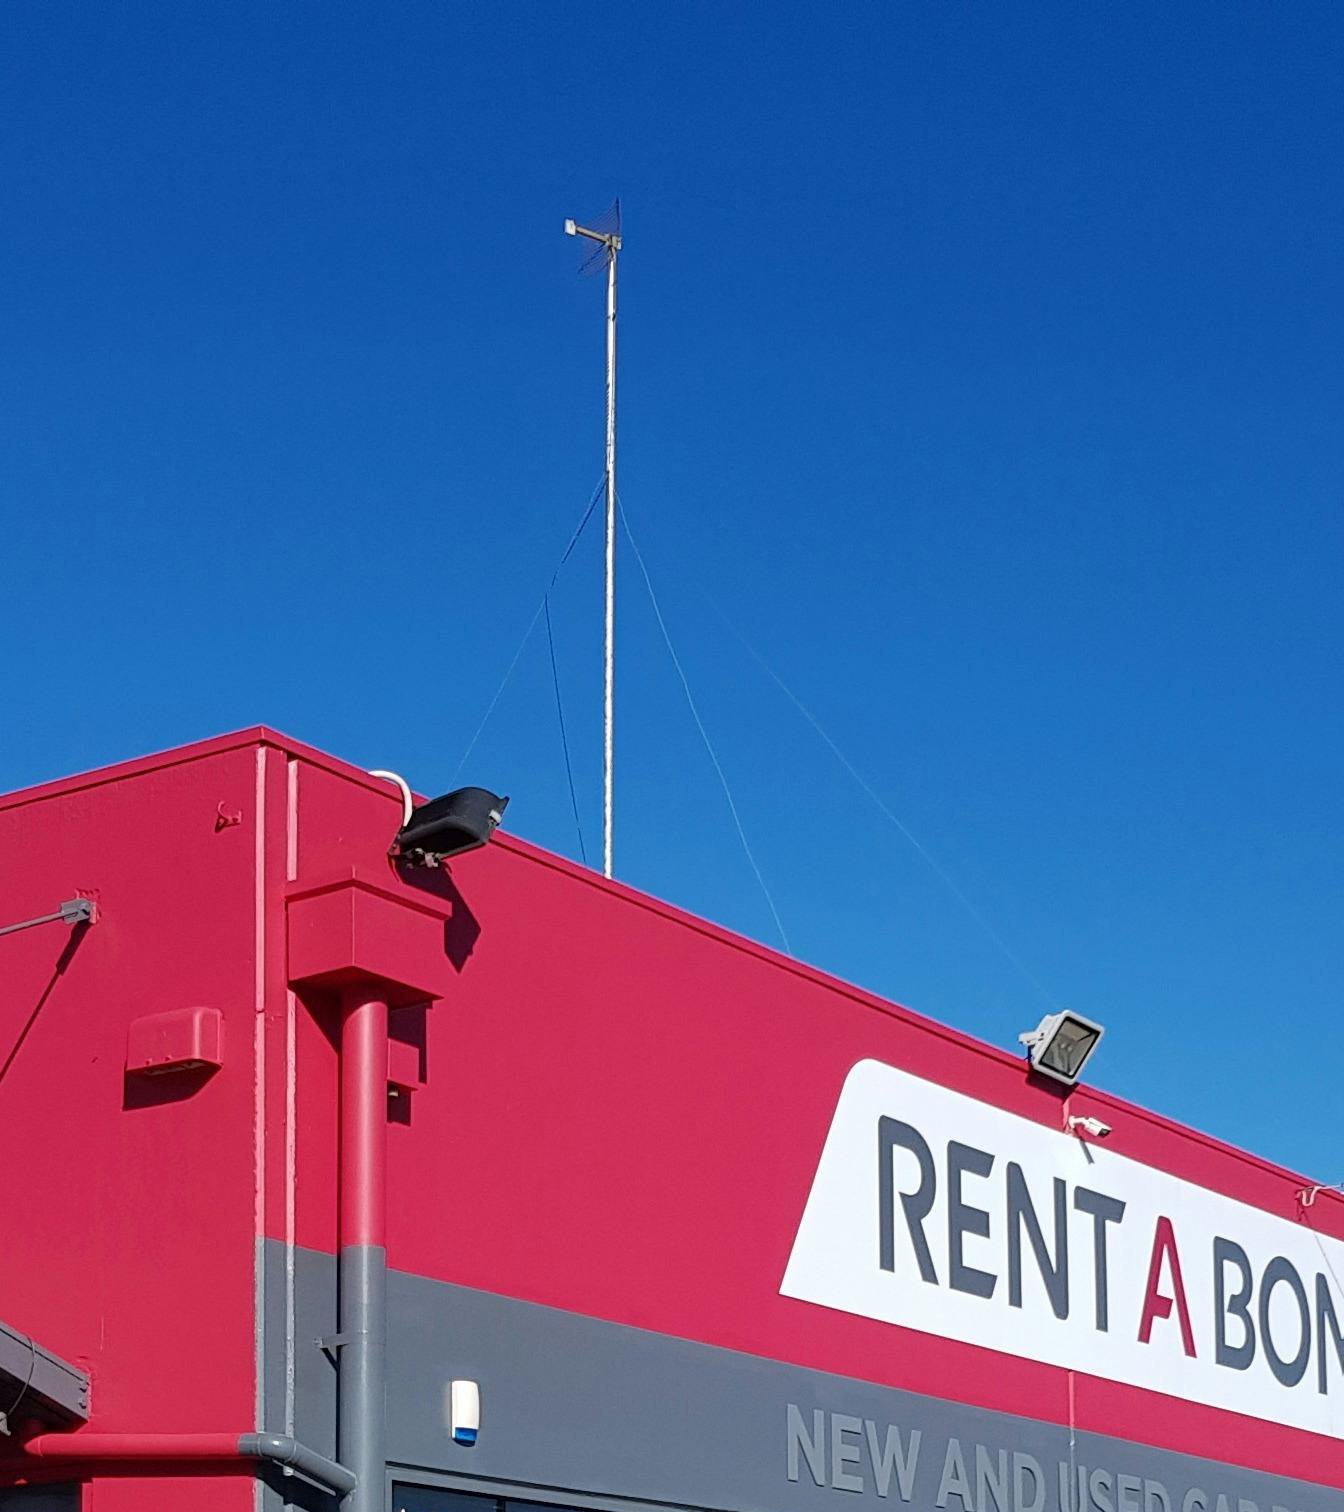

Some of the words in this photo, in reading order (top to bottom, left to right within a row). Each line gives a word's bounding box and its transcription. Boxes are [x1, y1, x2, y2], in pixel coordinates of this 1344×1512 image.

[877, 1113, 1127, 1333] RENT
[1137, 1215, 1197, 1359] A
[786, 1403, 922, 1502] NEW
